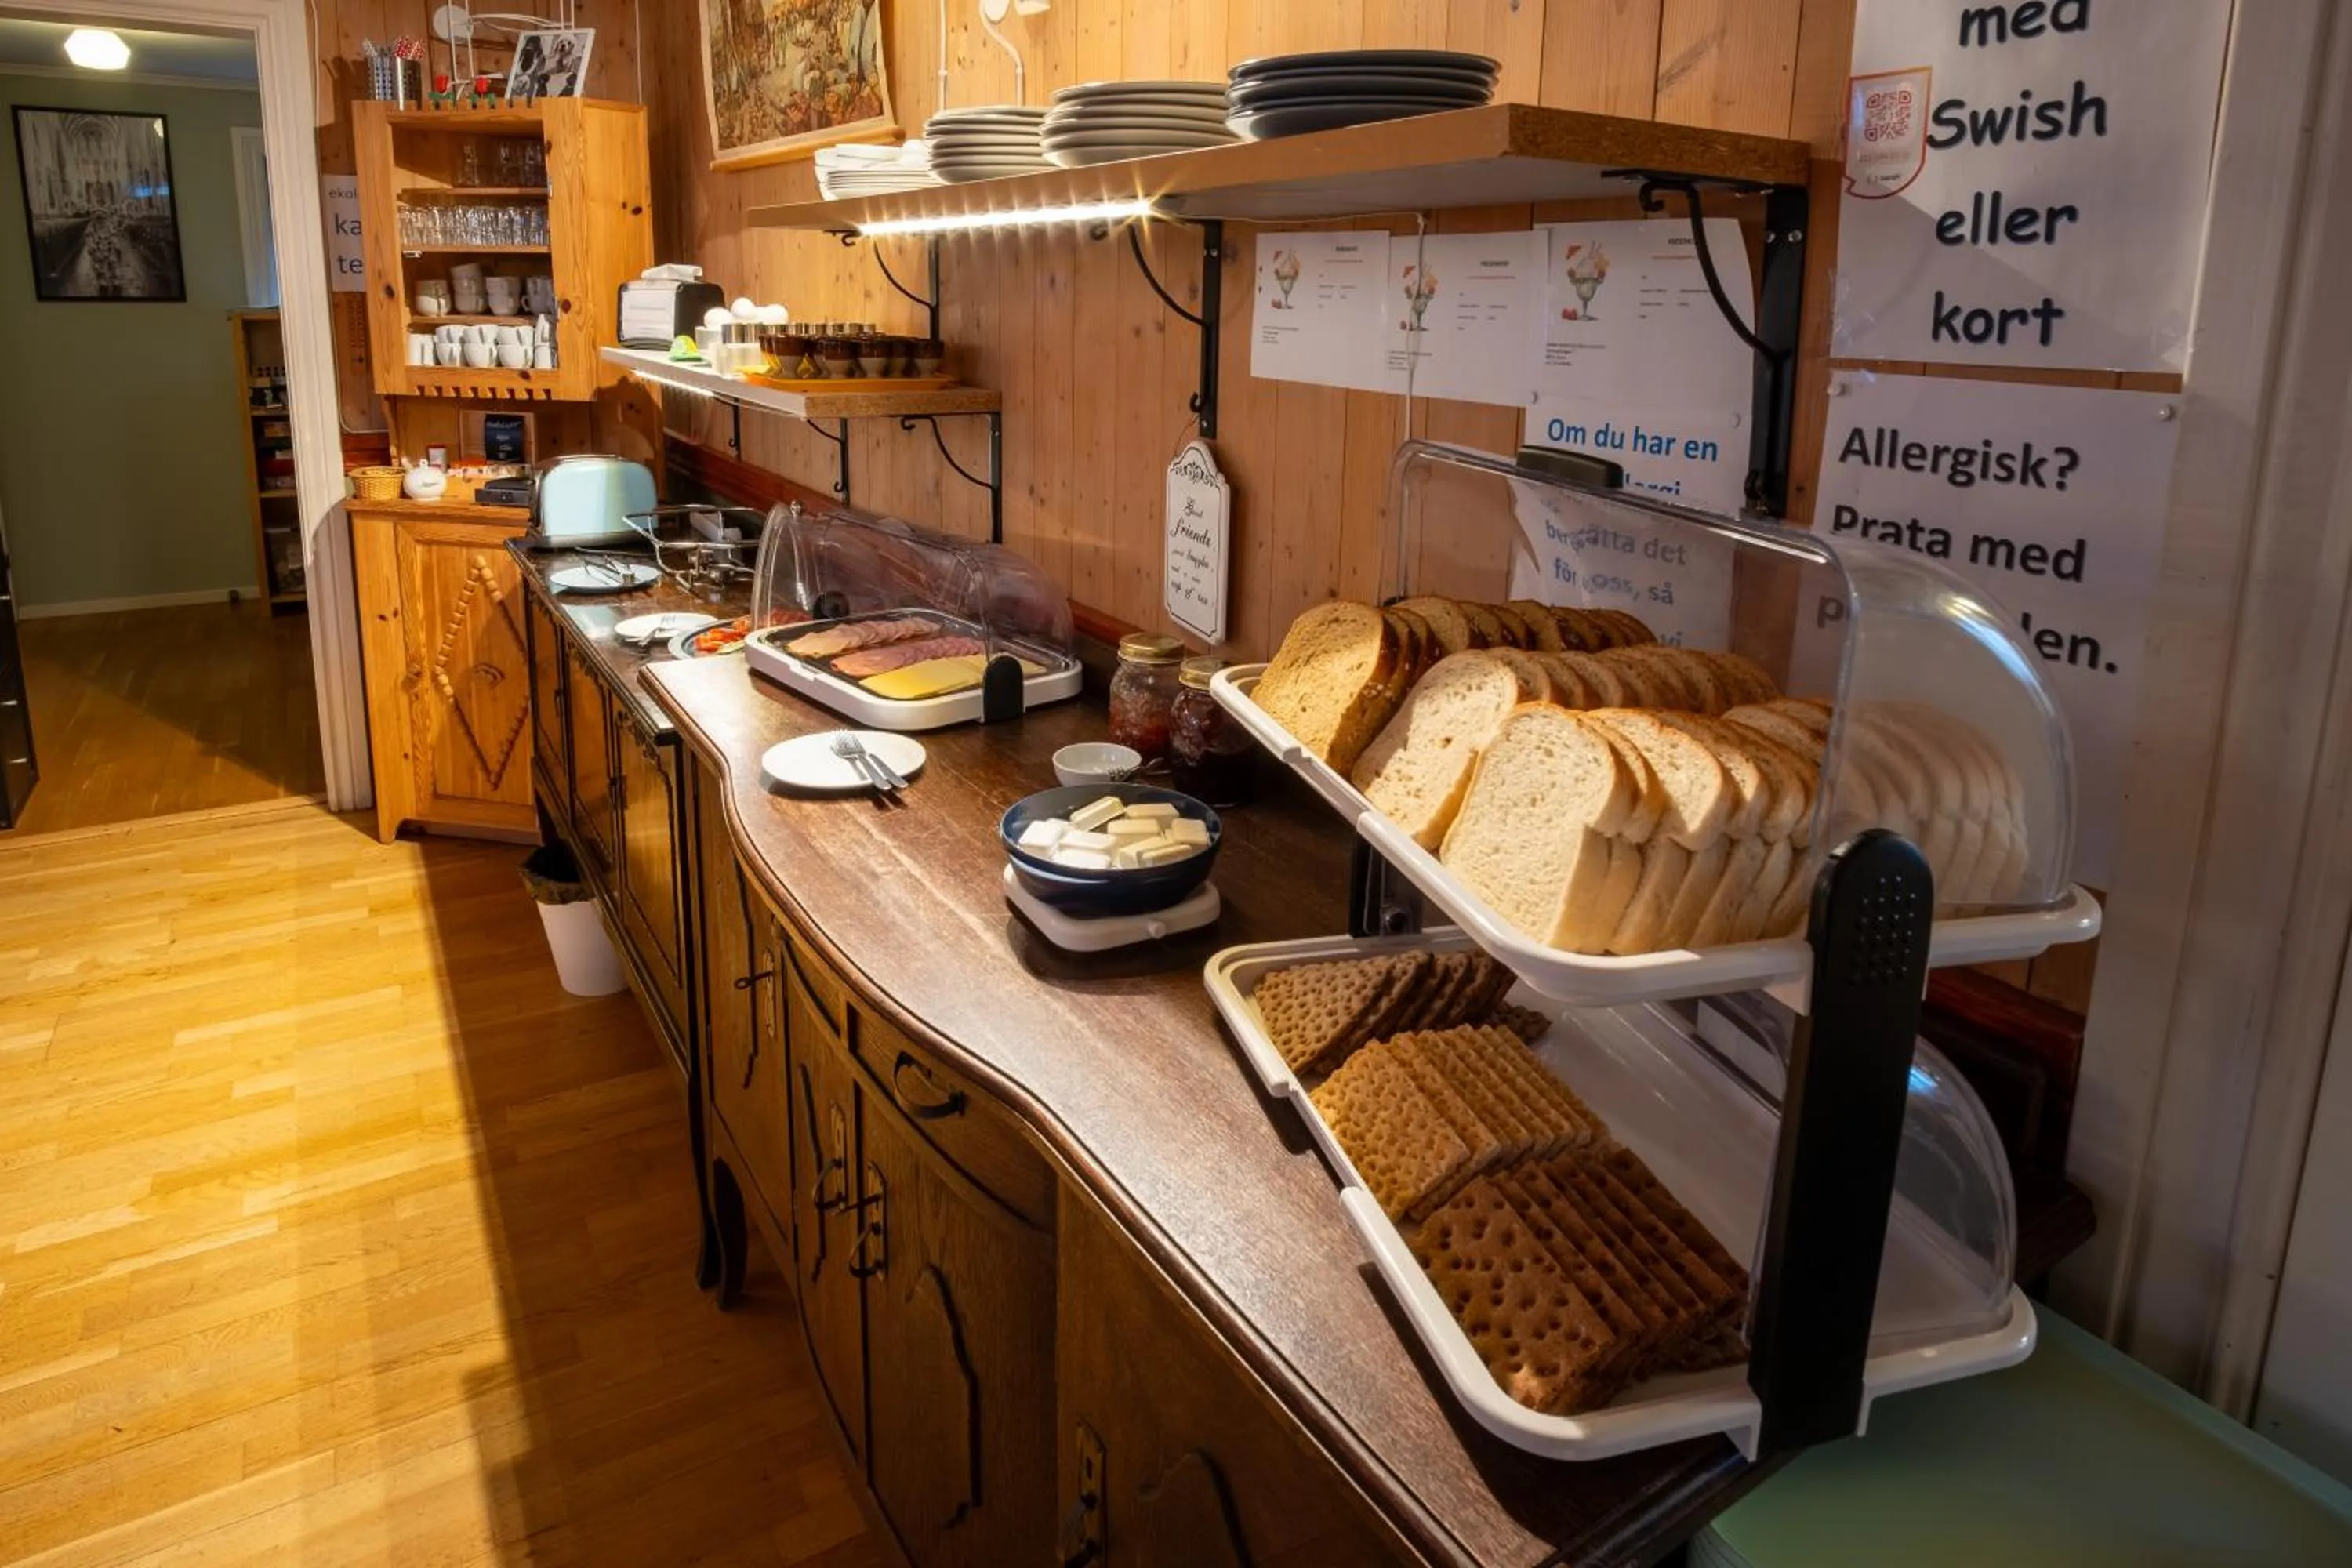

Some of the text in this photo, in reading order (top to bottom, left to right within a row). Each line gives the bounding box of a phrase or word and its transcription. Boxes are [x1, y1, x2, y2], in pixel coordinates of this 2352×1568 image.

[1959, 0, 2089, 47] med
[1926, 80, 2107, 149] Swish
[1935, 191, 2079, 245] eller
[337, 255, 364, 274] te
[1931, 290, 2065, 347] kort
[1548, 418, 1718, 462] Om du har en
[1838, 427, 2081, 491] Allergisk?
[1643, 538, 1686, 566] det
[1832, 504, 2087, 583] Prata med
[1648, 581, 1675, 605] så
